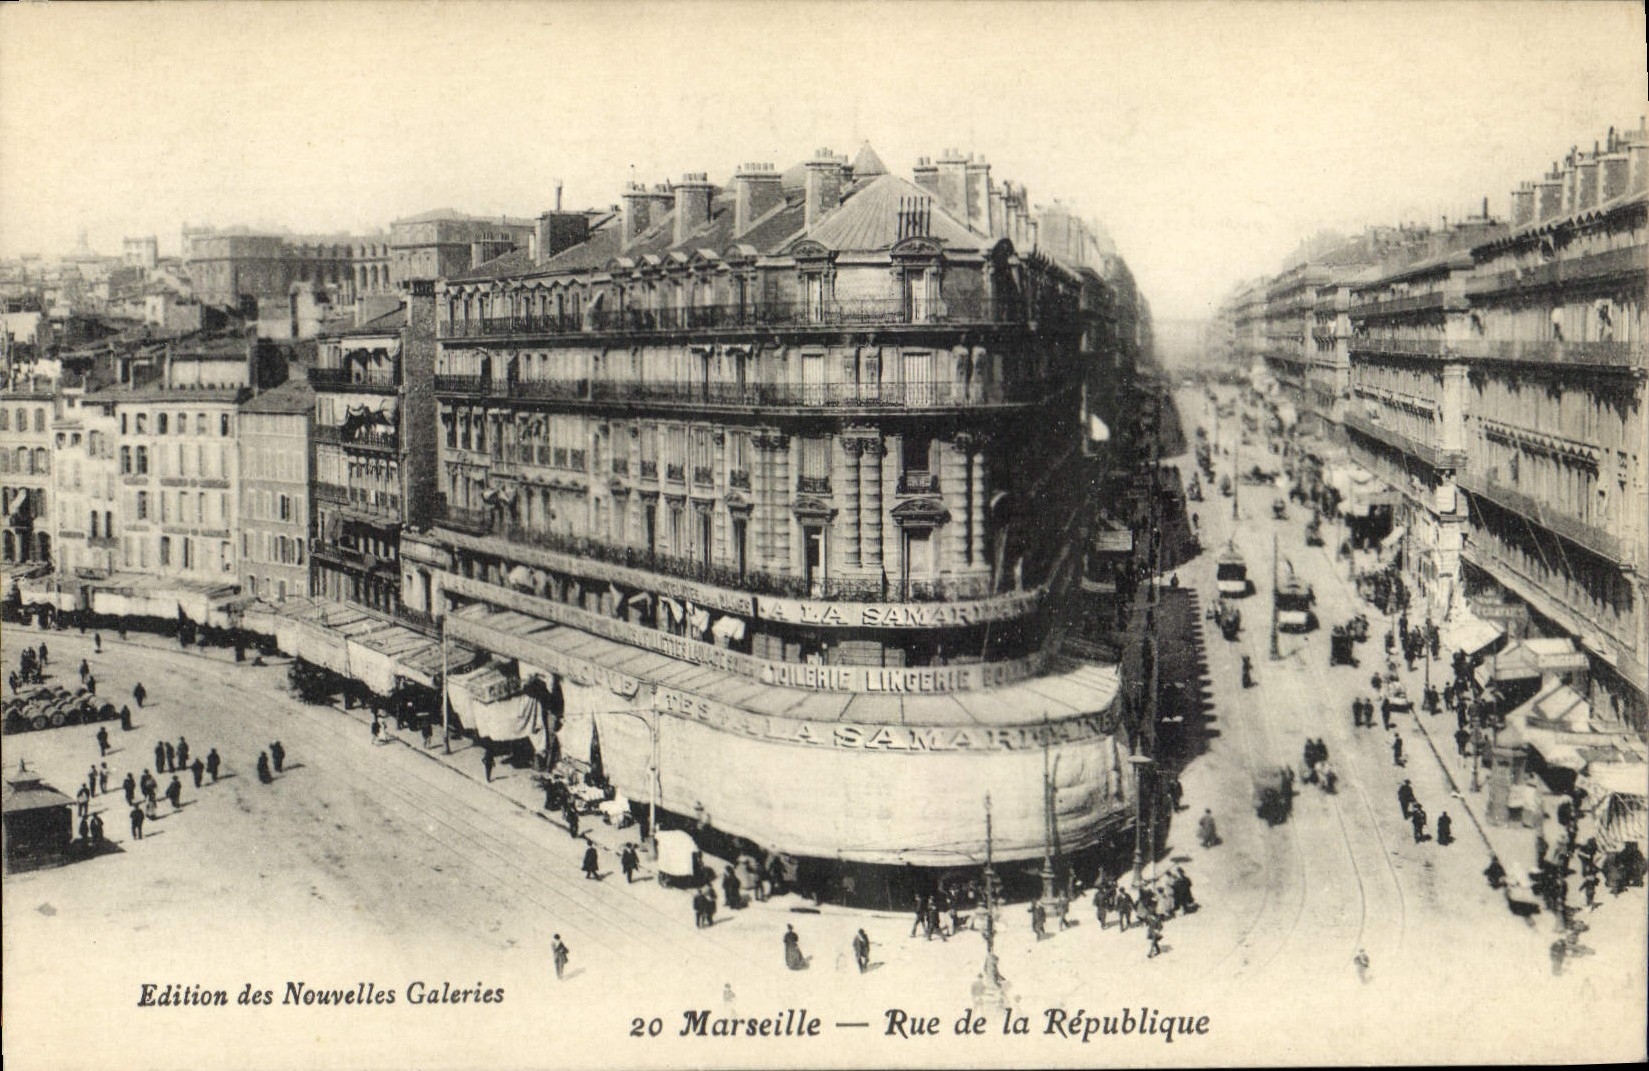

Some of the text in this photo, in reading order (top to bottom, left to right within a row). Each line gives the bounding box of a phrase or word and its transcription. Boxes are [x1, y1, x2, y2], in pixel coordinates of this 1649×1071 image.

[800, 602, 849, 625] LA
[865, 668, 970, 693] LINGERIE
[763, 718, 824, 745] LA
